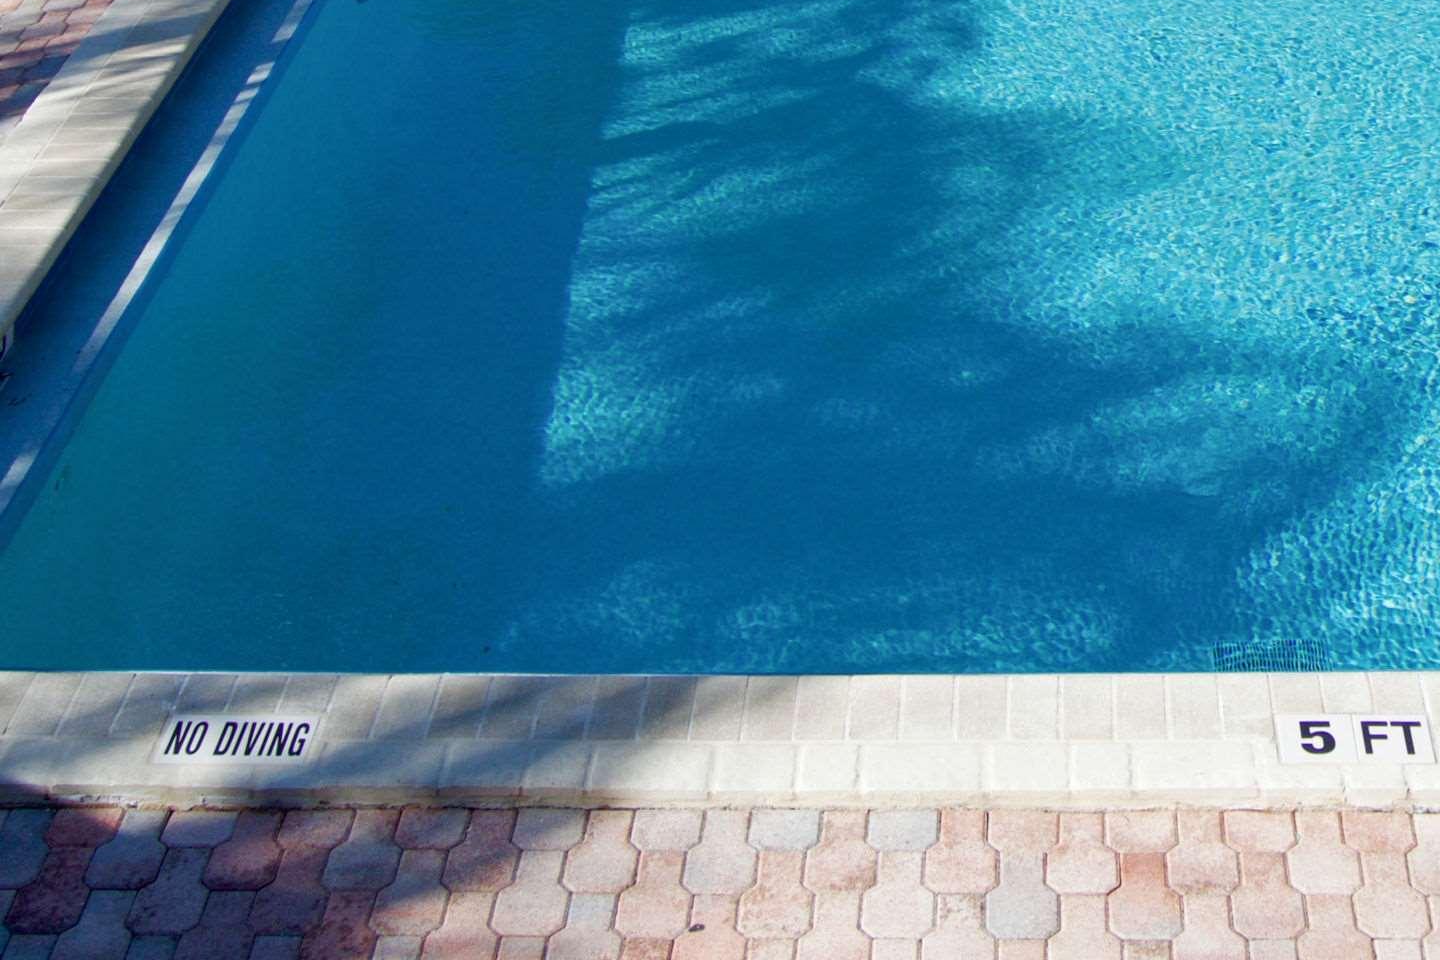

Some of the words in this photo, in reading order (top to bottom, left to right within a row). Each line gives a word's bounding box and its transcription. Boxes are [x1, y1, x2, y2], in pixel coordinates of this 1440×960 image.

[164, 721, 209, 756] NO
[213, 721, 311, 756] DIVING
[1299, 721, 1336, 754] 5
[1360, 721, 1422, 755] FT
